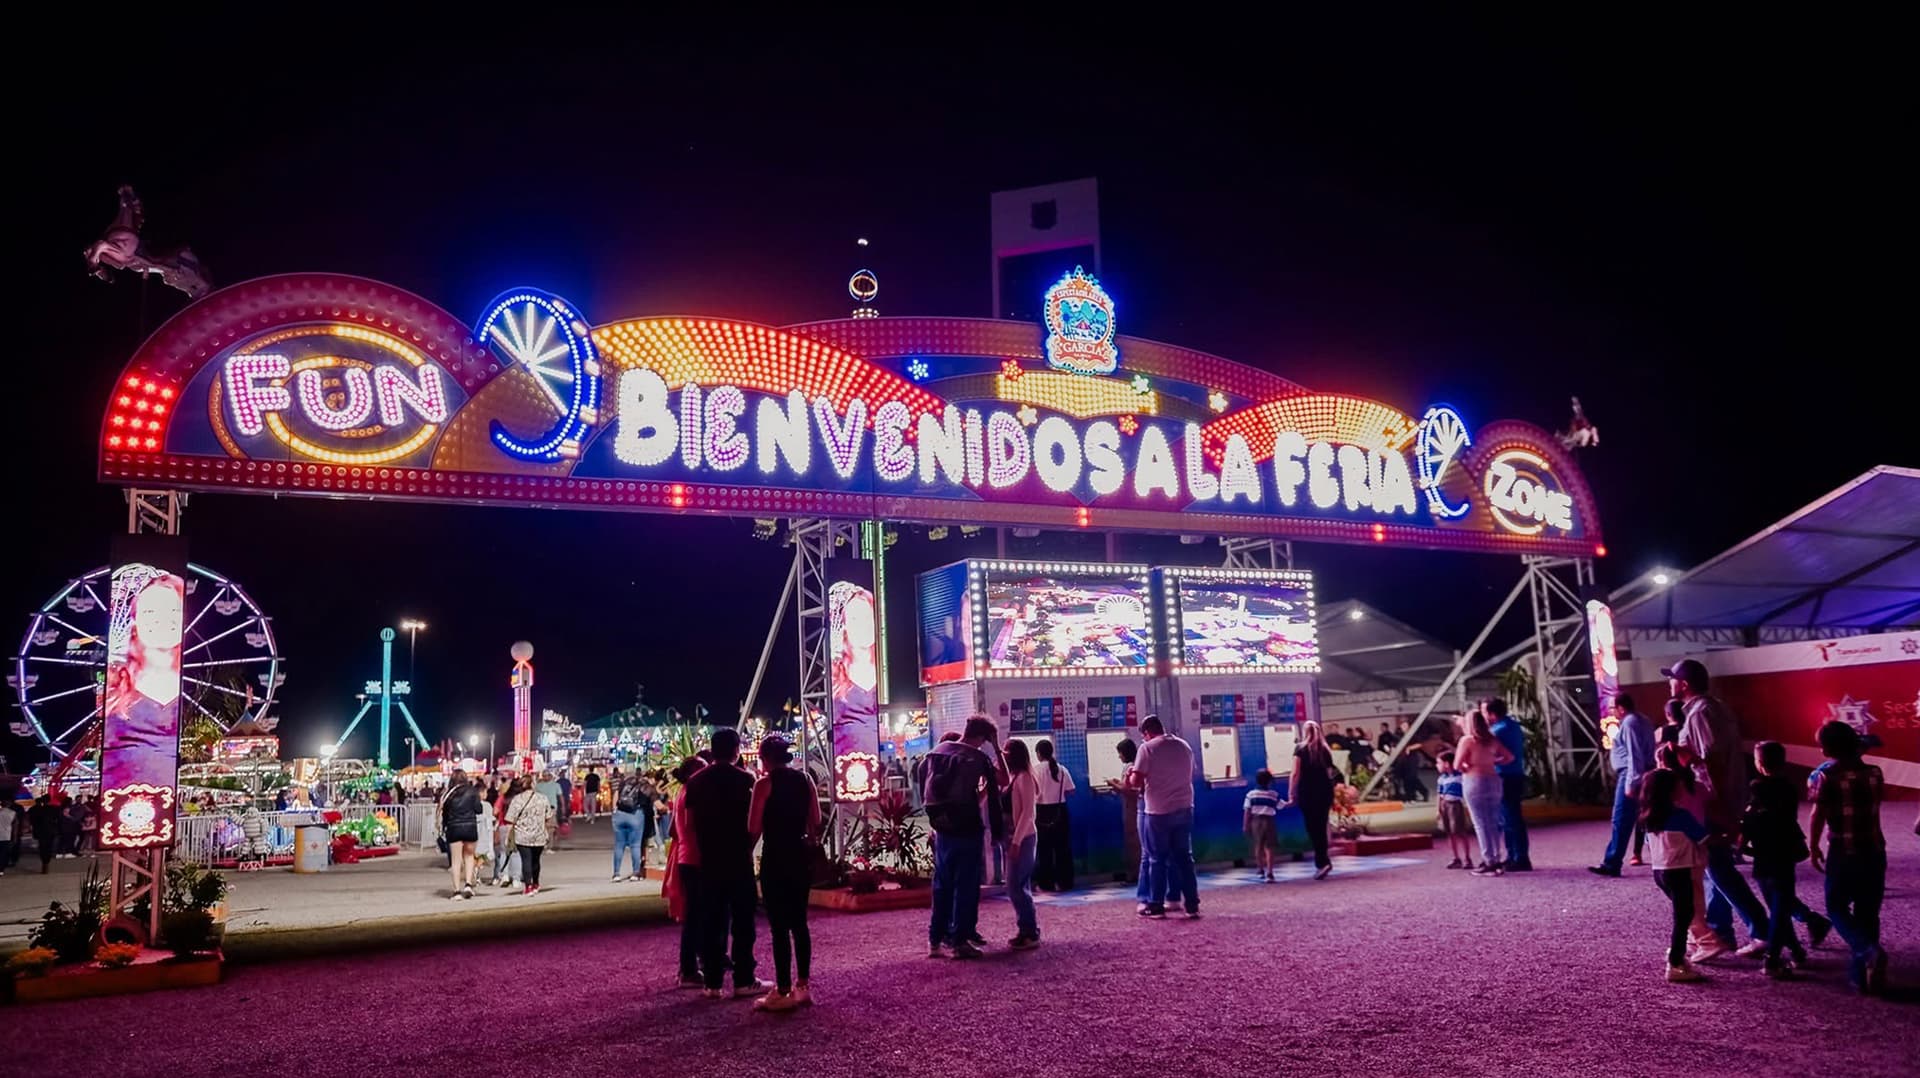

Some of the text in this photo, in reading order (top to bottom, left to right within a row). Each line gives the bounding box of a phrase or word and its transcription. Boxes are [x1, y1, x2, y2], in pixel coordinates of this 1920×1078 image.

[224, 354, 449, 436] FUN
[614, 367, 1417, 515] BIENVENIDOS A LA FERIA
[1488, 459, 1573, 531] ZONE
